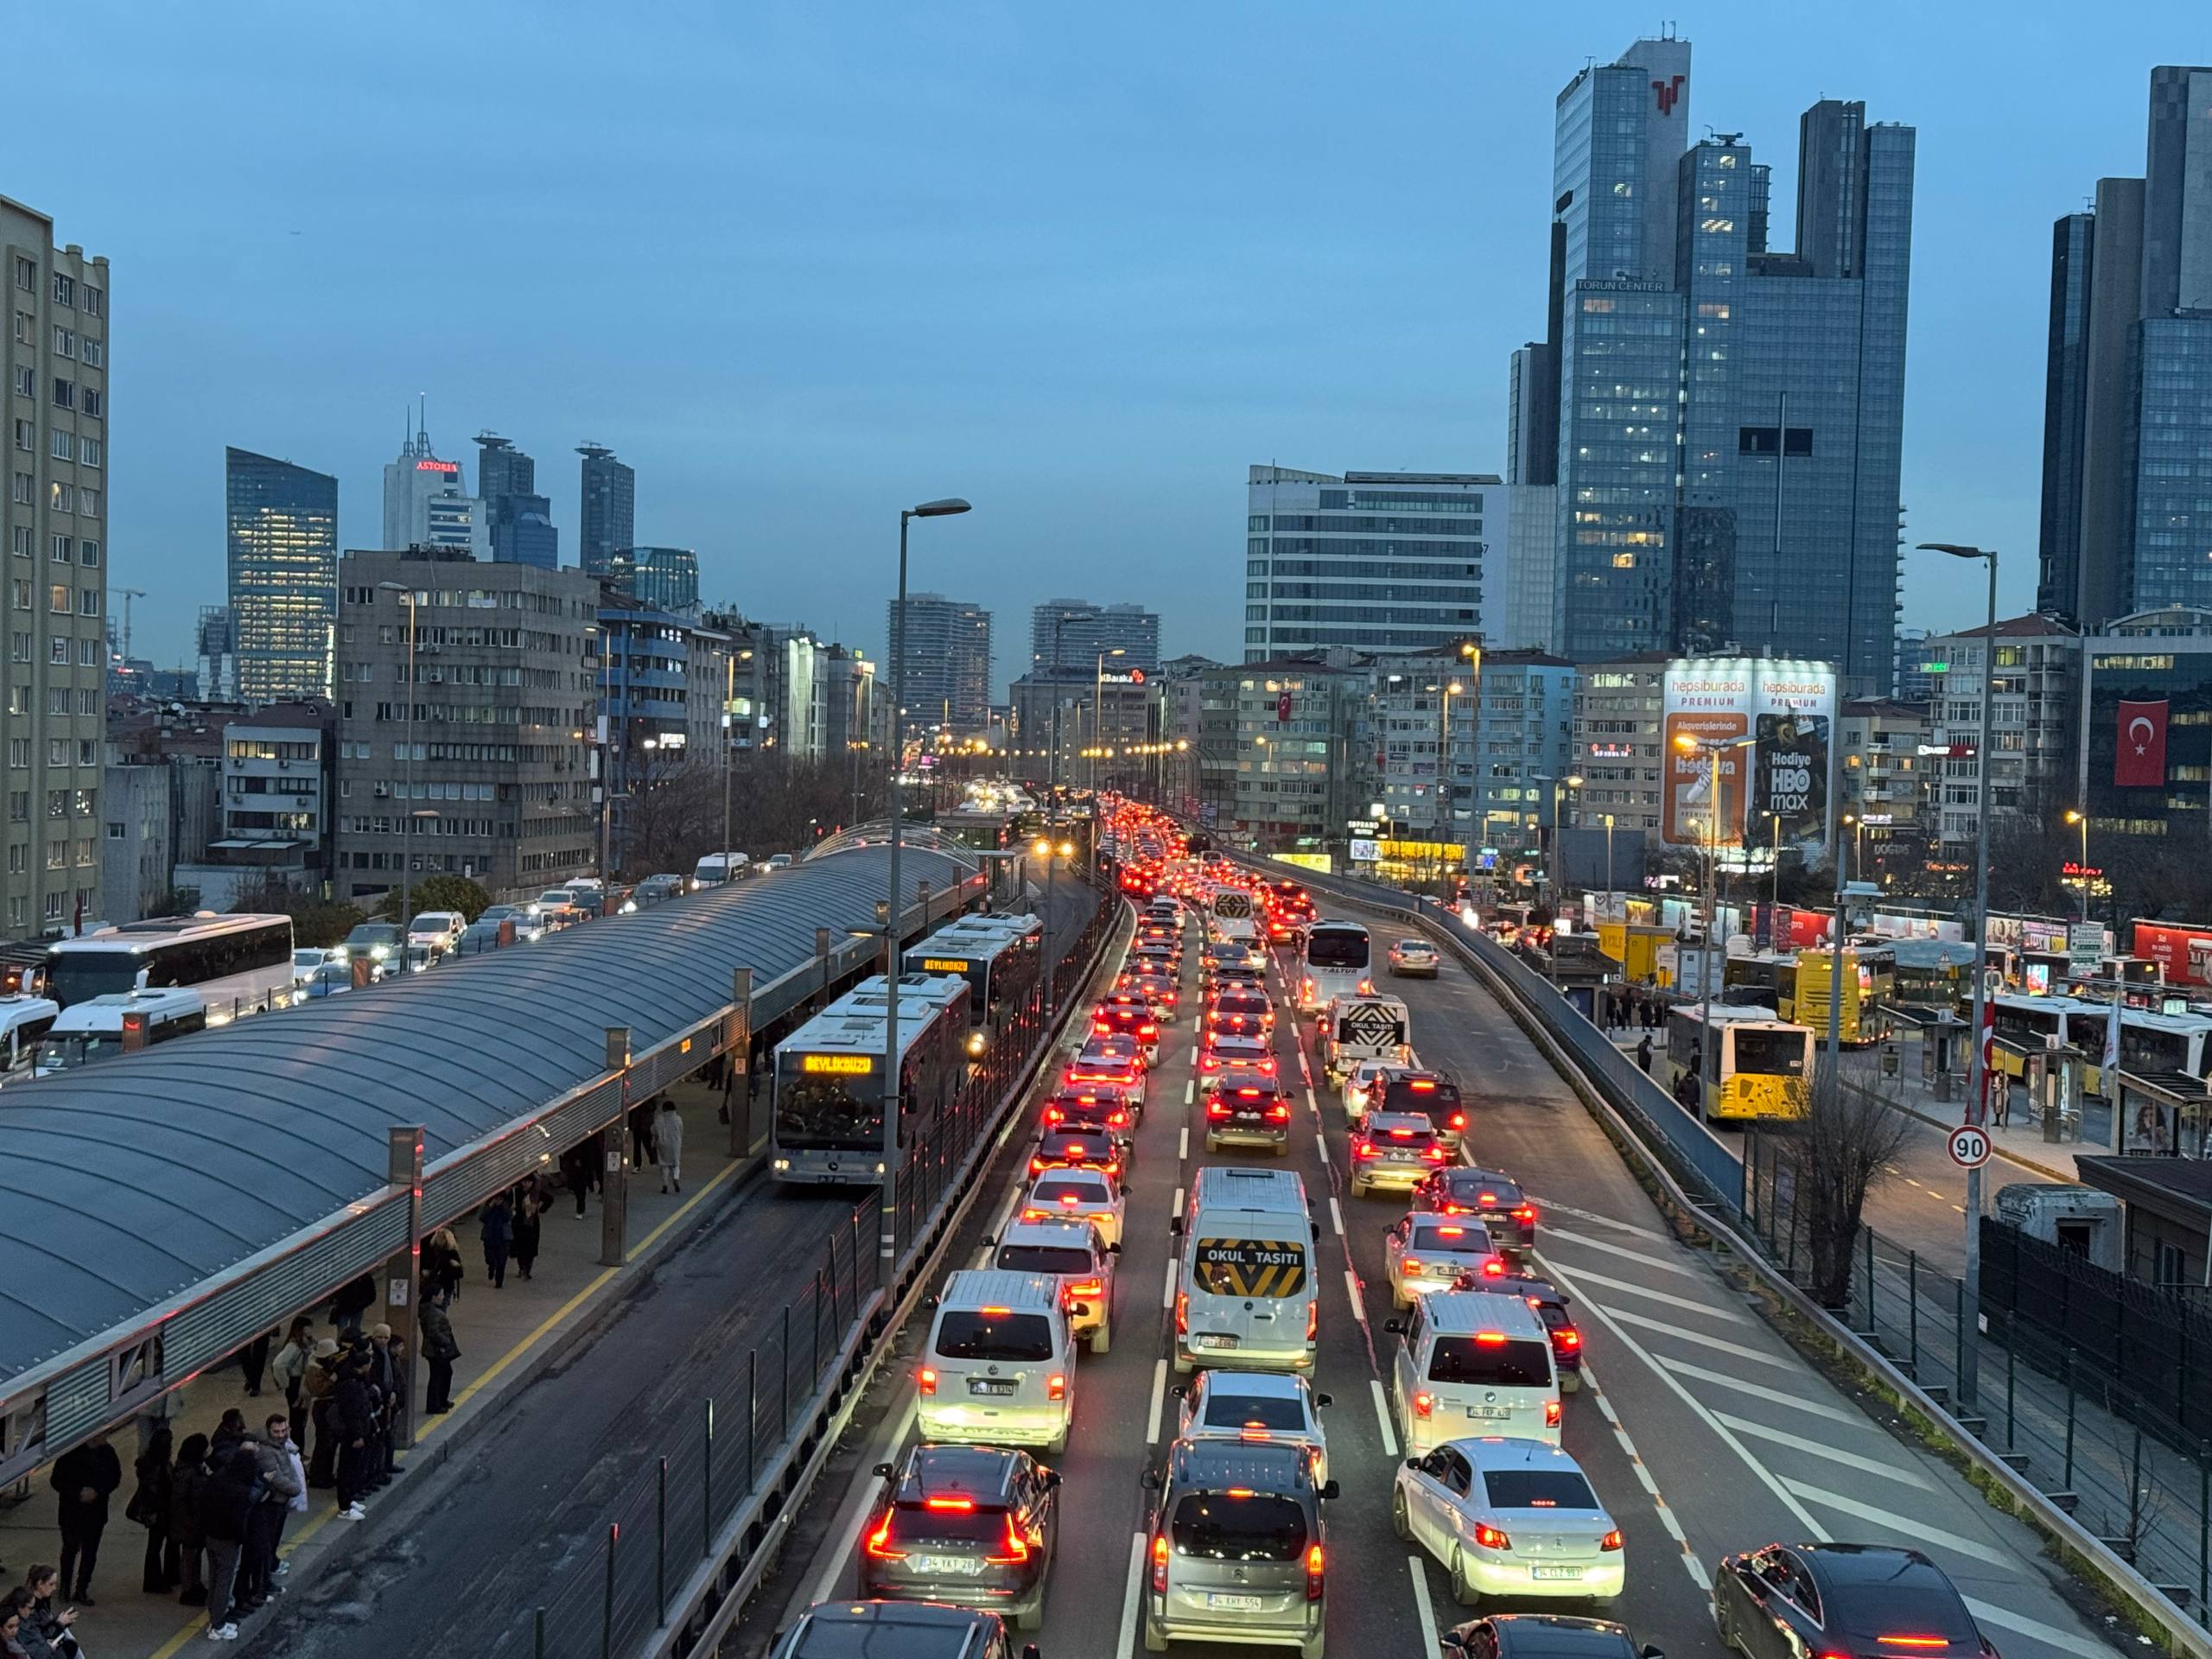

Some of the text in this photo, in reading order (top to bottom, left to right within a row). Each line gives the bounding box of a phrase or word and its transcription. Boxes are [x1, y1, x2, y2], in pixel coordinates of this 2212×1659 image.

[1577, 280, 1663, 291] TORUN CENTER
[416, 461, 457, 473] ASTORIA
[1672, 680, 1745, 695] hepsiburada
[1762, 681, 1826, 696] hepsiburada
[1681, 697, 1734, 706] PREMIUM
[1772, 752, 1812, 768] Hediye
[1771, 768, 1811, 793] HBO
[1770, 794, 1808, 810] max
[1956, 1138, 1983, 1158] 90
[1208, 1249, 1298, 1265] OKUL TAŞITI
